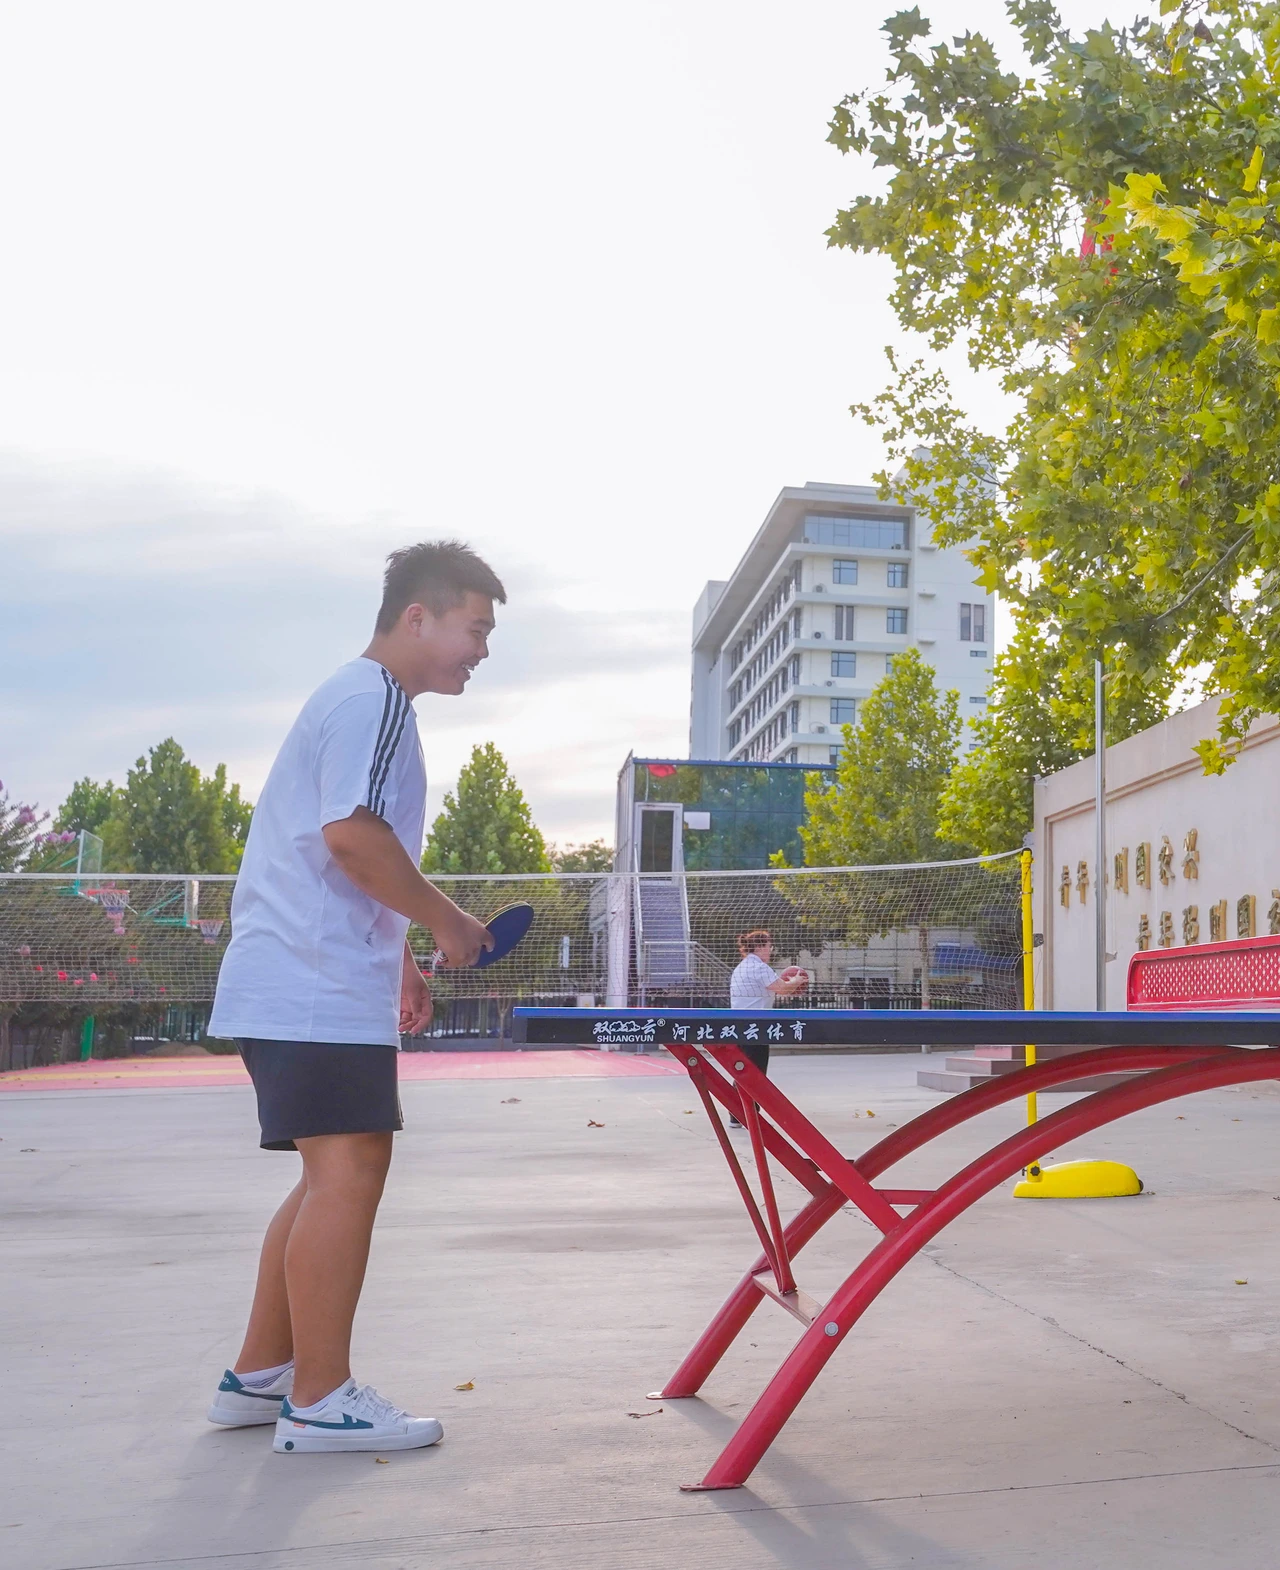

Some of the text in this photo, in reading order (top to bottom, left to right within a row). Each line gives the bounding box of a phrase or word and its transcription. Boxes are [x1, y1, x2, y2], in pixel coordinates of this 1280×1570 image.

[1058, 828, 1200, 908] 青年则国家兴
[597, 1034, 654, 1043] SHUANGYUN
[672, 1020, 807, 1042] 河北双云体育
